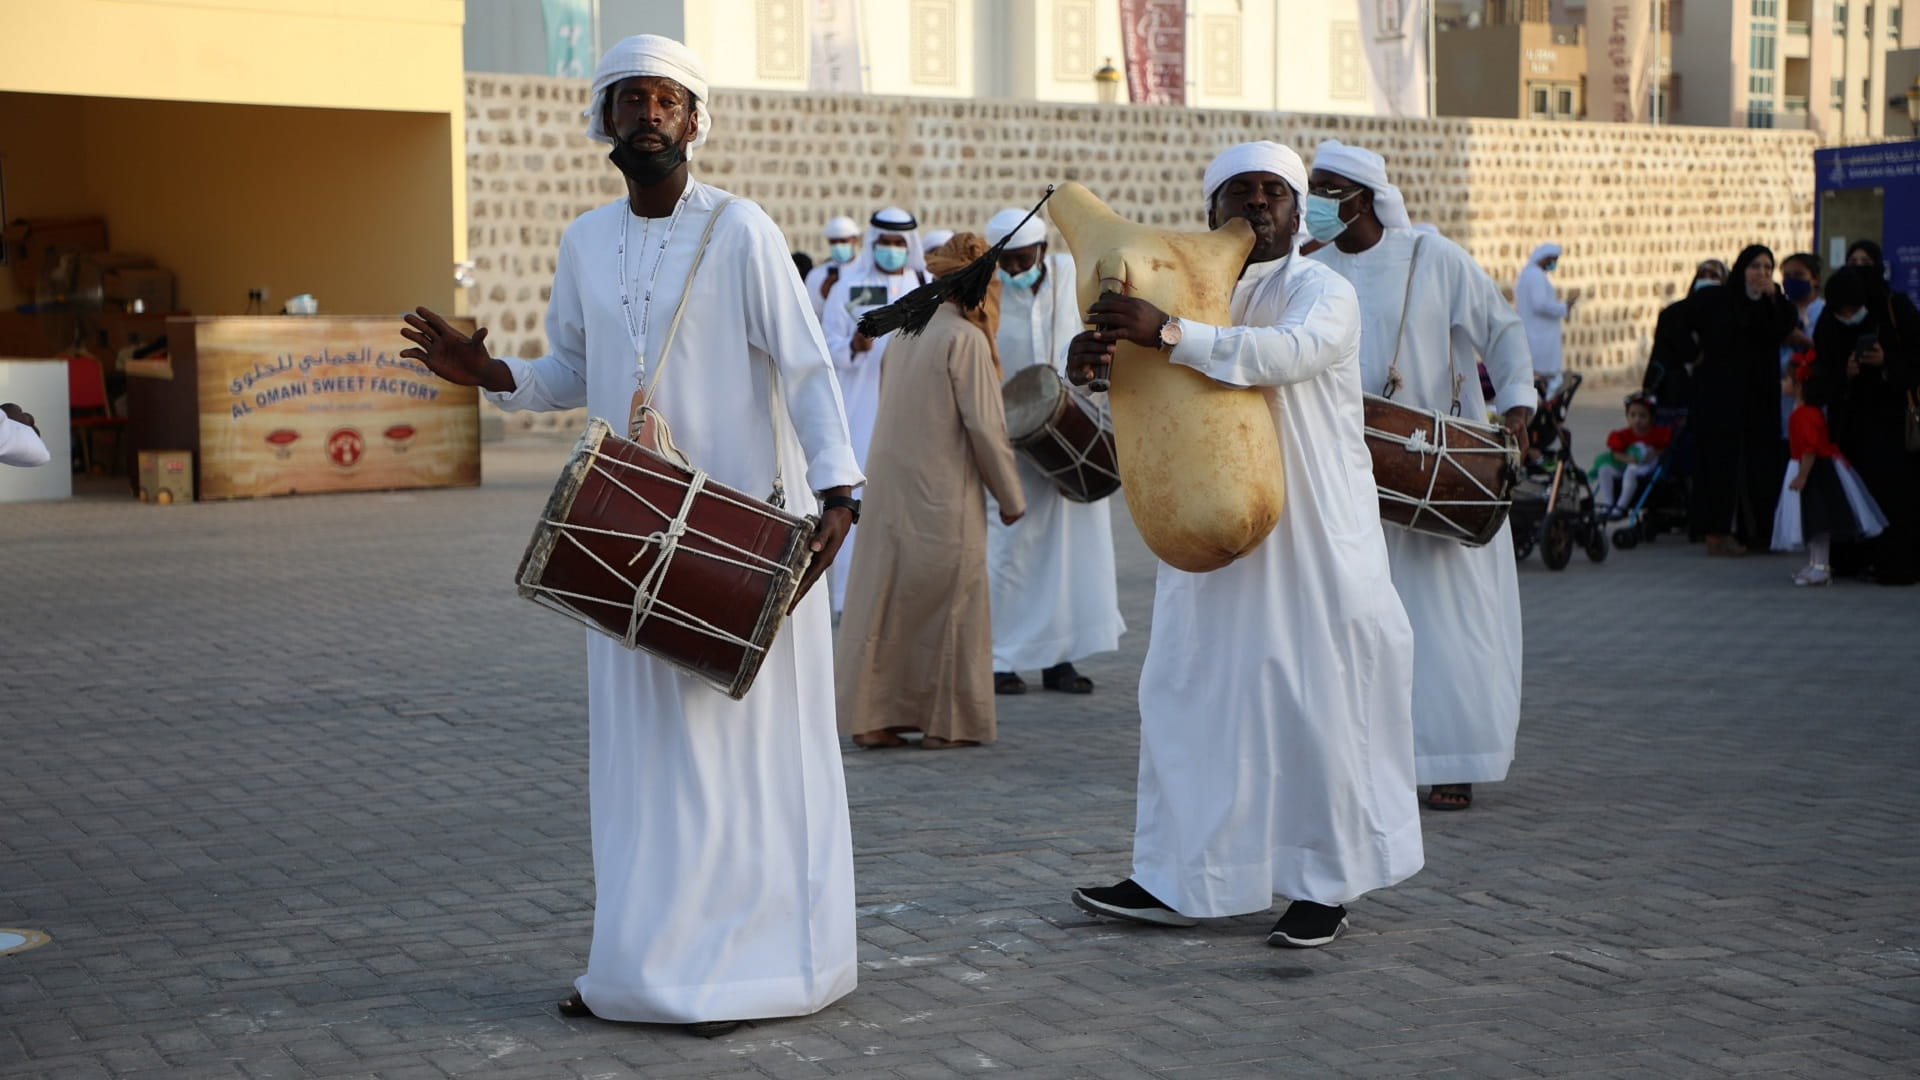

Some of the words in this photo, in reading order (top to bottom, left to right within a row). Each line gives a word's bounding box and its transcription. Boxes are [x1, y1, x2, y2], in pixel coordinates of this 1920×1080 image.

[299, 347, 371, 375] العماني
[232, 401, 252, 419] AL
[255, 381, 307, 408] OMANI
[312, 375, 366, 394] SWEET
[371, 375, 438, 401] FACTORY
